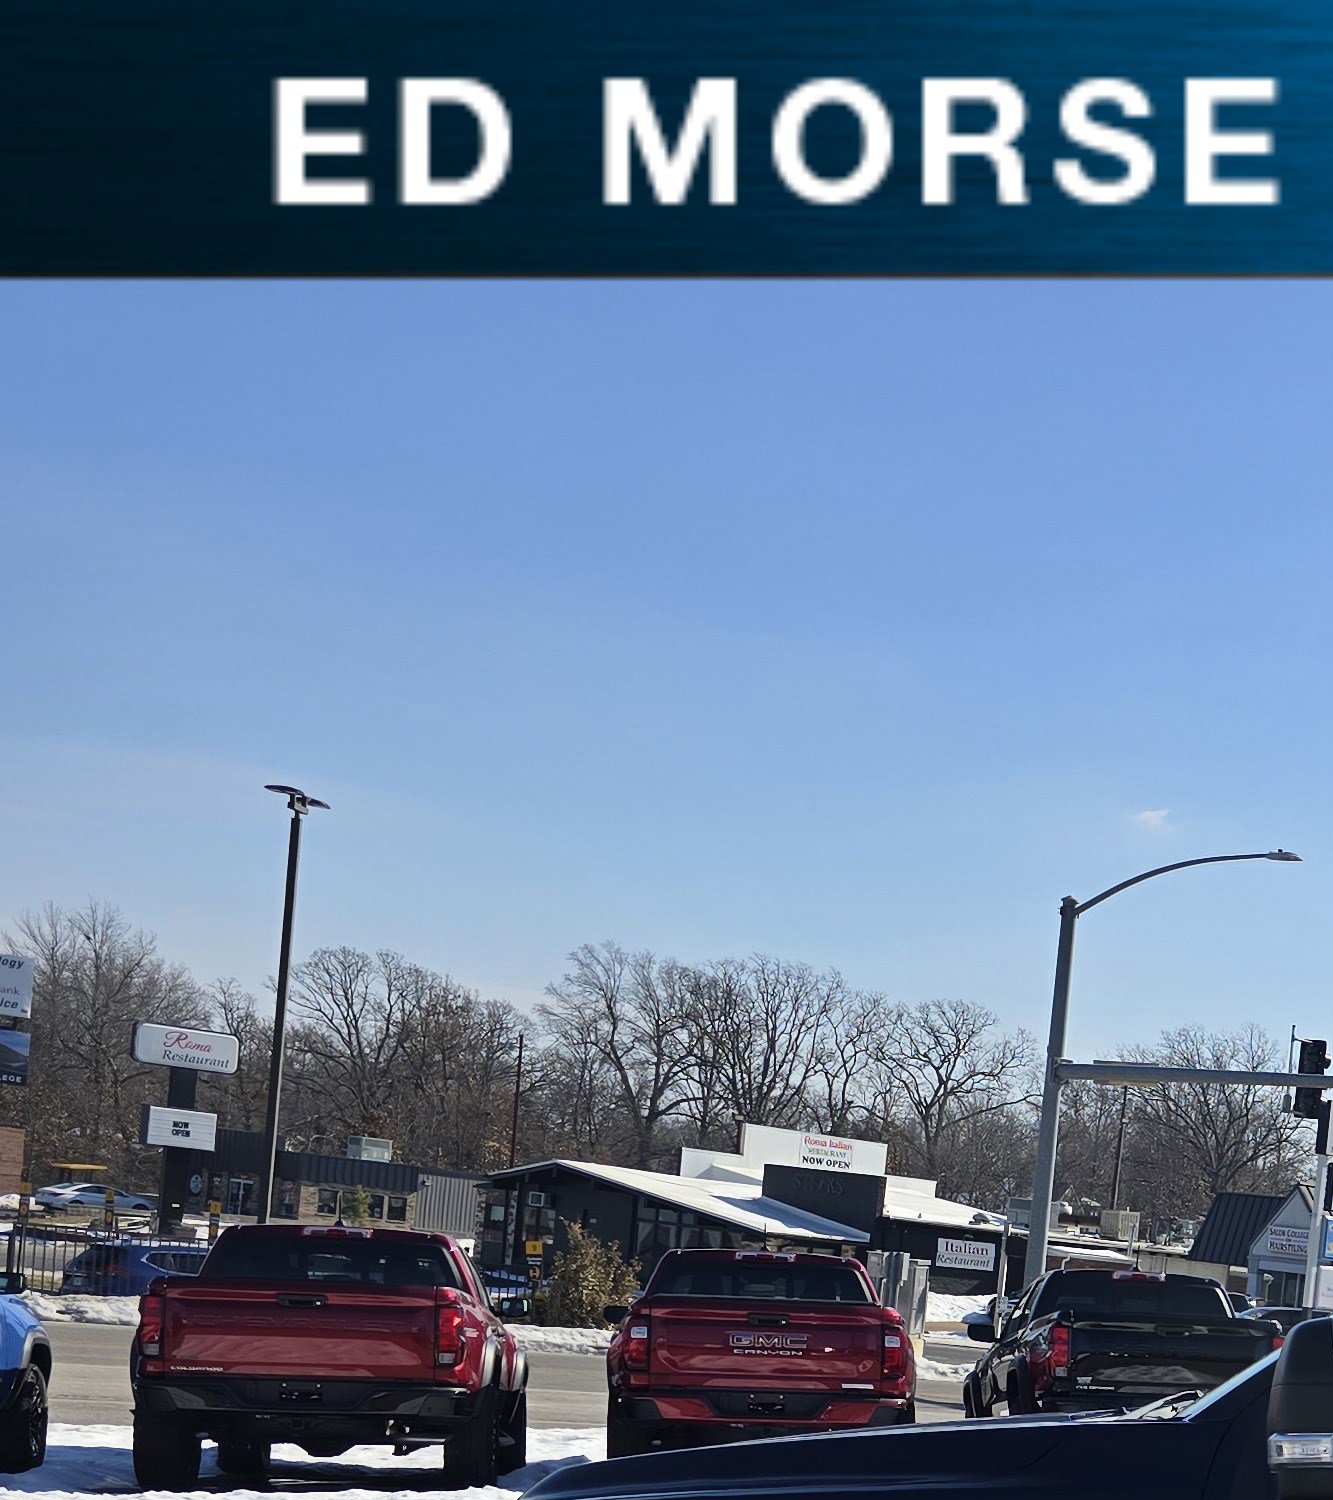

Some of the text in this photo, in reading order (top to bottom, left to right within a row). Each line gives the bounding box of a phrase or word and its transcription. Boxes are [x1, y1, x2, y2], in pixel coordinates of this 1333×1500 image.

[163, 1031, 212, 1053] Roma
[162, 1050, 230, 1068] Restaurant
[0, 1074, 22, 1083] EGE
[172, 1120, 190, 1129] NOW
[171, 1129, 191, 1137] OPEN
[829, 1139, 853, 1151] Italian
[801, 1155, 851, 1170] NOW OPEN
[944, 1240, 989, 1256] Italian
[937, 1253, 990, 1268] Restaurant
[729, 1333, 807, 1348] GMC
[733, 1348, 803, 1356] CANYON
